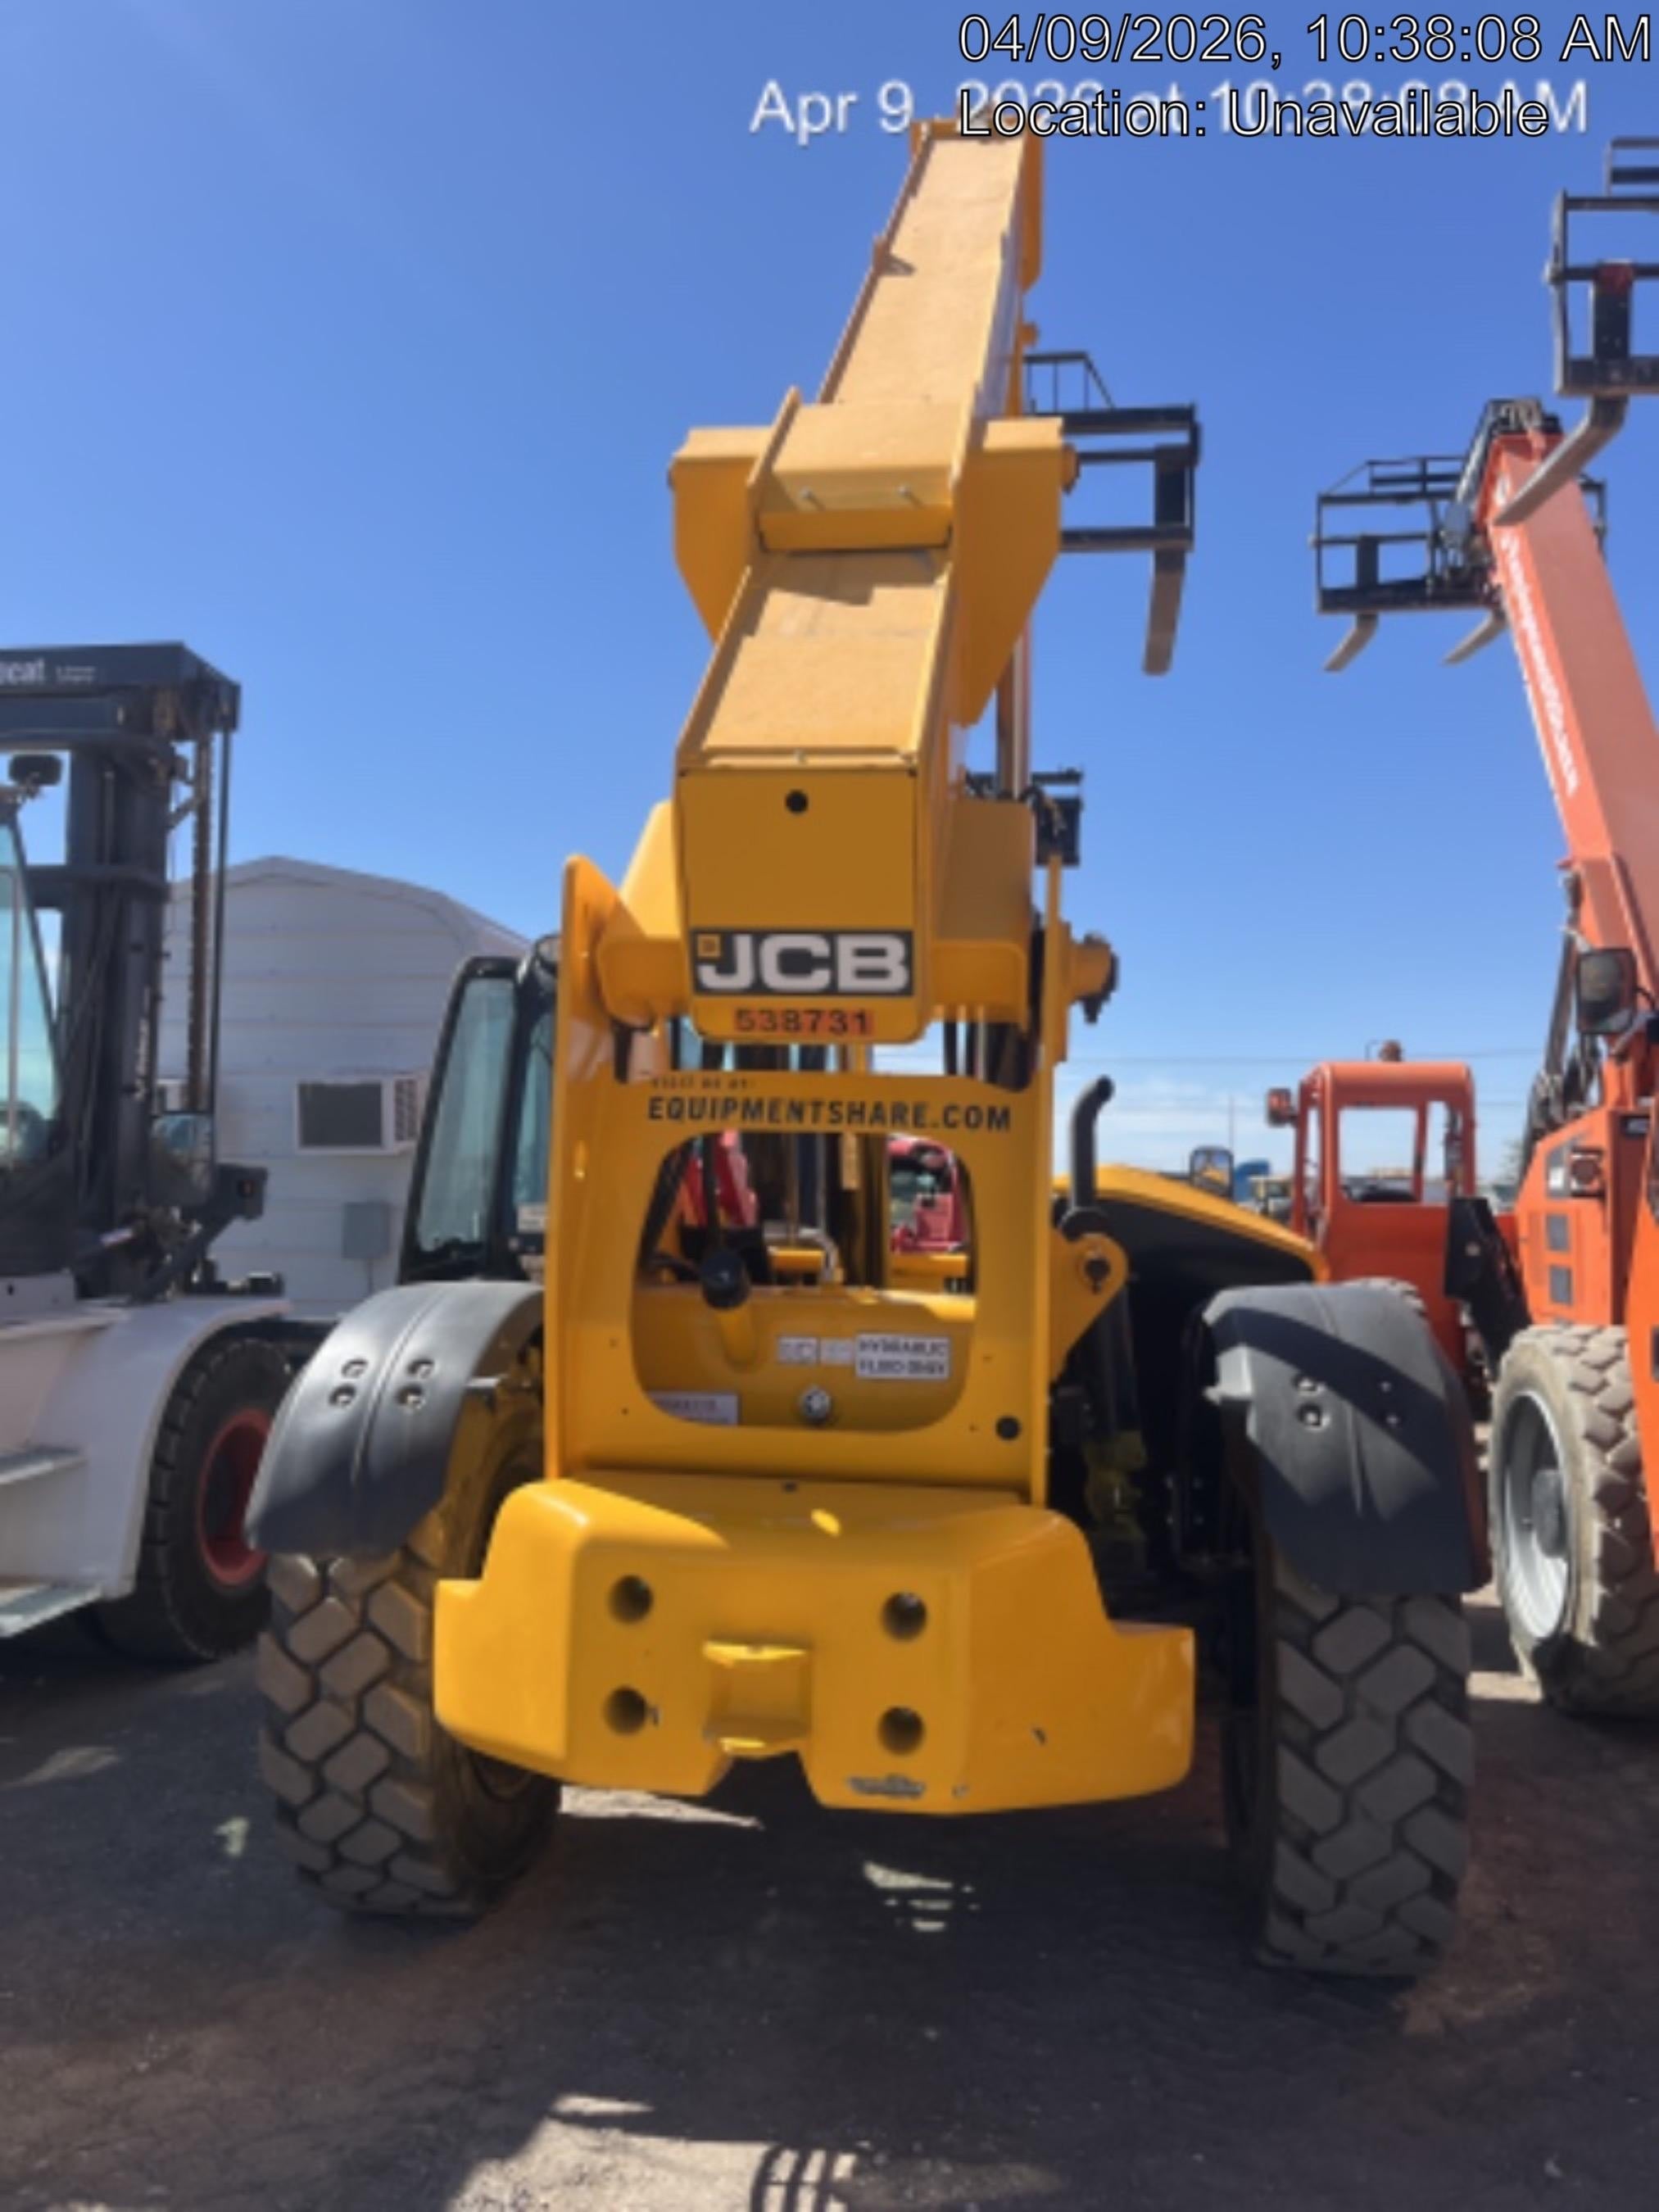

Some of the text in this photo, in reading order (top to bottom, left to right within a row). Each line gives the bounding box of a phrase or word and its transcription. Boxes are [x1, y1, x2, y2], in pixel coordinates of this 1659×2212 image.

[696, 933, 909, 992] JCB
[736, 1008, 870, 1036] 538731
[648, 1096, 1012, 1131] EQUIPMENTSHARE.COM
